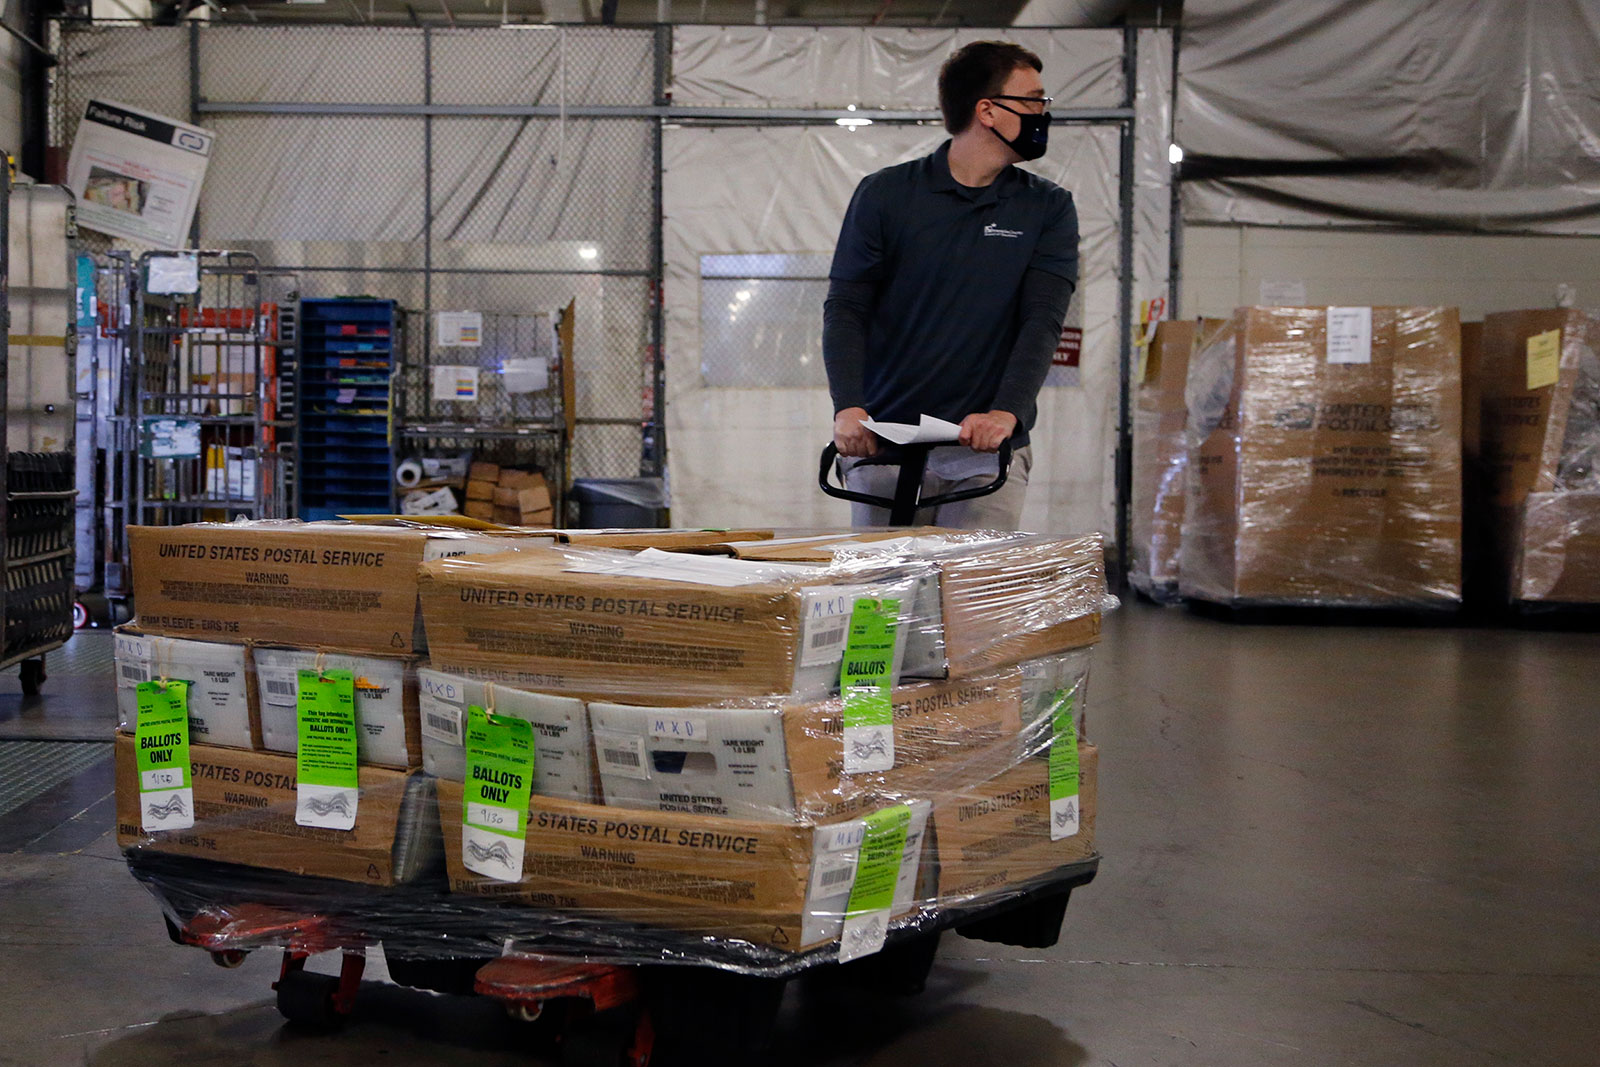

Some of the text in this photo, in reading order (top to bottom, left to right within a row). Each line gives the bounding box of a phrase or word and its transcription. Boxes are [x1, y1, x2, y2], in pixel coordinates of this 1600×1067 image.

[160, 543, 385, 567] UNITED STATES POSTAL SERVICE
[245, 571, 289, 585] WARNING
[460, 587, 745, 623] UNITED STATES POSTAL SERVICE
[161, 616, 195, 629] SLEEVE
[201, 619, 222, 631] EIRS
[223, 621, 240, 633] 75E
[569, 621, 624, 639] WARNING
[468, 667, 509, 682] SLEEVE
[847, 660, 886, 676] BALLOTS
[915, 694, 953, 715] POSTAL
[309, 724, 348, 734] BALLOTS ONLY
[531, 721, 568, 732] TARE WEIGHT
[141, 732, 182, 749] BALLOTS
[722, 739, 764, 747] TARE WEIGHT
[150, 749, 173, 764] ONLY
[190, 762, 298, 791] STATES POSTAL
[473, 765, 522, 789] BALLOTS
[224, 791, 268, 808] WARNING
[480, 785, 510, 804] ONLY
[660, 793, 722, 805] UNITED STATES
[959, 783, 1050, 822] UNITED STATES POSTA
[660, 803, 728, 815] POSTAL SERVICE
[119, 824, 138, 837] EMM
[537, 811, 598, 835] STATES
[604, 821, 671, 844] POSTAL
[677, 829, 758, 854] SERVICE
[581, 845, 636, 865] WARNING
[531, 892, 556, 905] EIRS
